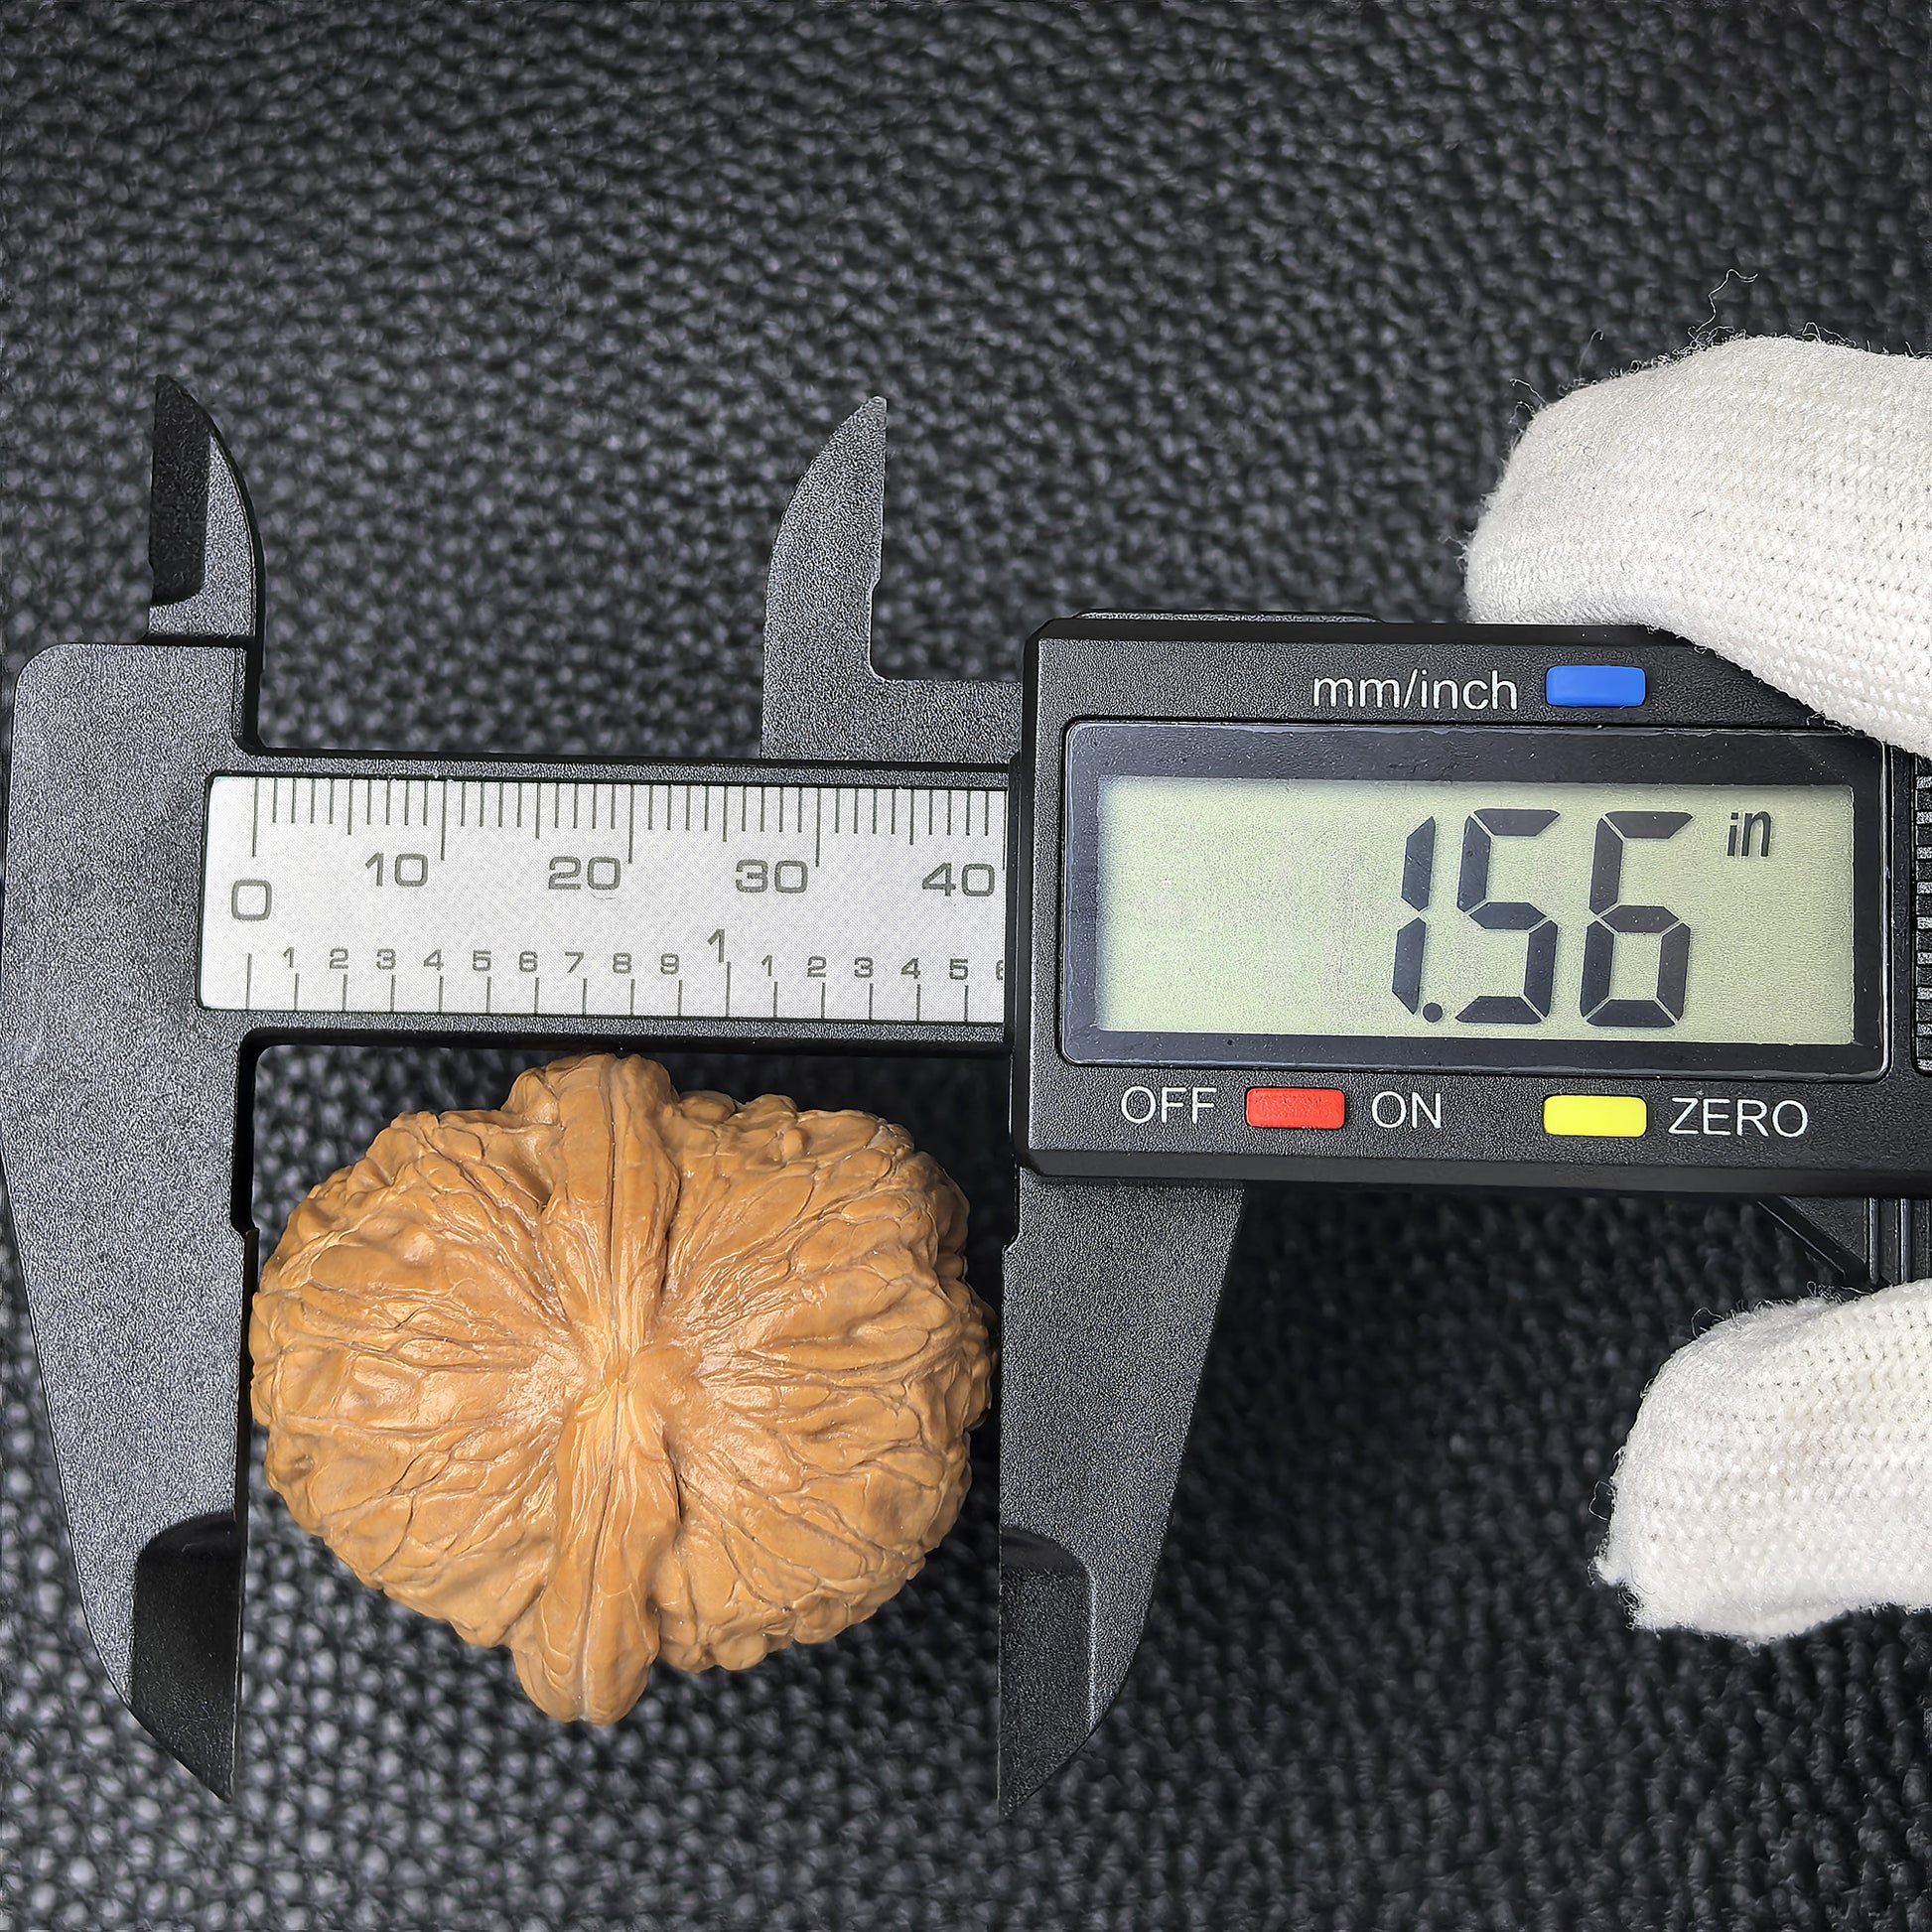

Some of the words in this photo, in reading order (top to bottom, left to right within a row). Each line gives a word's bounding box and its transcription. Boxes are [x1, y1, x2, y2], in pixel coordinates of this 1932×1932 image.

[1314, 669, 1516, 709] mm/inch
[365, 853, 428, 887] 10
[548, 856, 621, 891] 20
[736, 859, 808, 894] 30
[922, 863, 995, 897] 40
[231, 879, 272, 921] 0
[1392, 808, 1693, 1029] 1.56
[1727, 811, 1772, 857] in
[283, 947, 294, 968] 1
[330, 947, 348, 969] 2
[376, 949, 395, 970] 3
[424, 949, 444, 971] 4
[473, 950, 491, 972] 5
[519, 951, 537, 972] 6
[565, 951, 584, 973] 7
[613, 953, 631, 974] 8
[660, 953, 679, 975] 9
[708, 929, 725, 961] 1
[761, 955, 772, 977] 1
[807, 956, 826, 977] 2
[854, 957, 873, 978] 3
[900, 958, 920, 979] 4
[949, 959, 968, 980] 5
[1122, 1086, 1216, 1124] OFF
[1372, 1091, 1441, 1128] ON
[1669, 1098, 1808, 1137] ZERO
